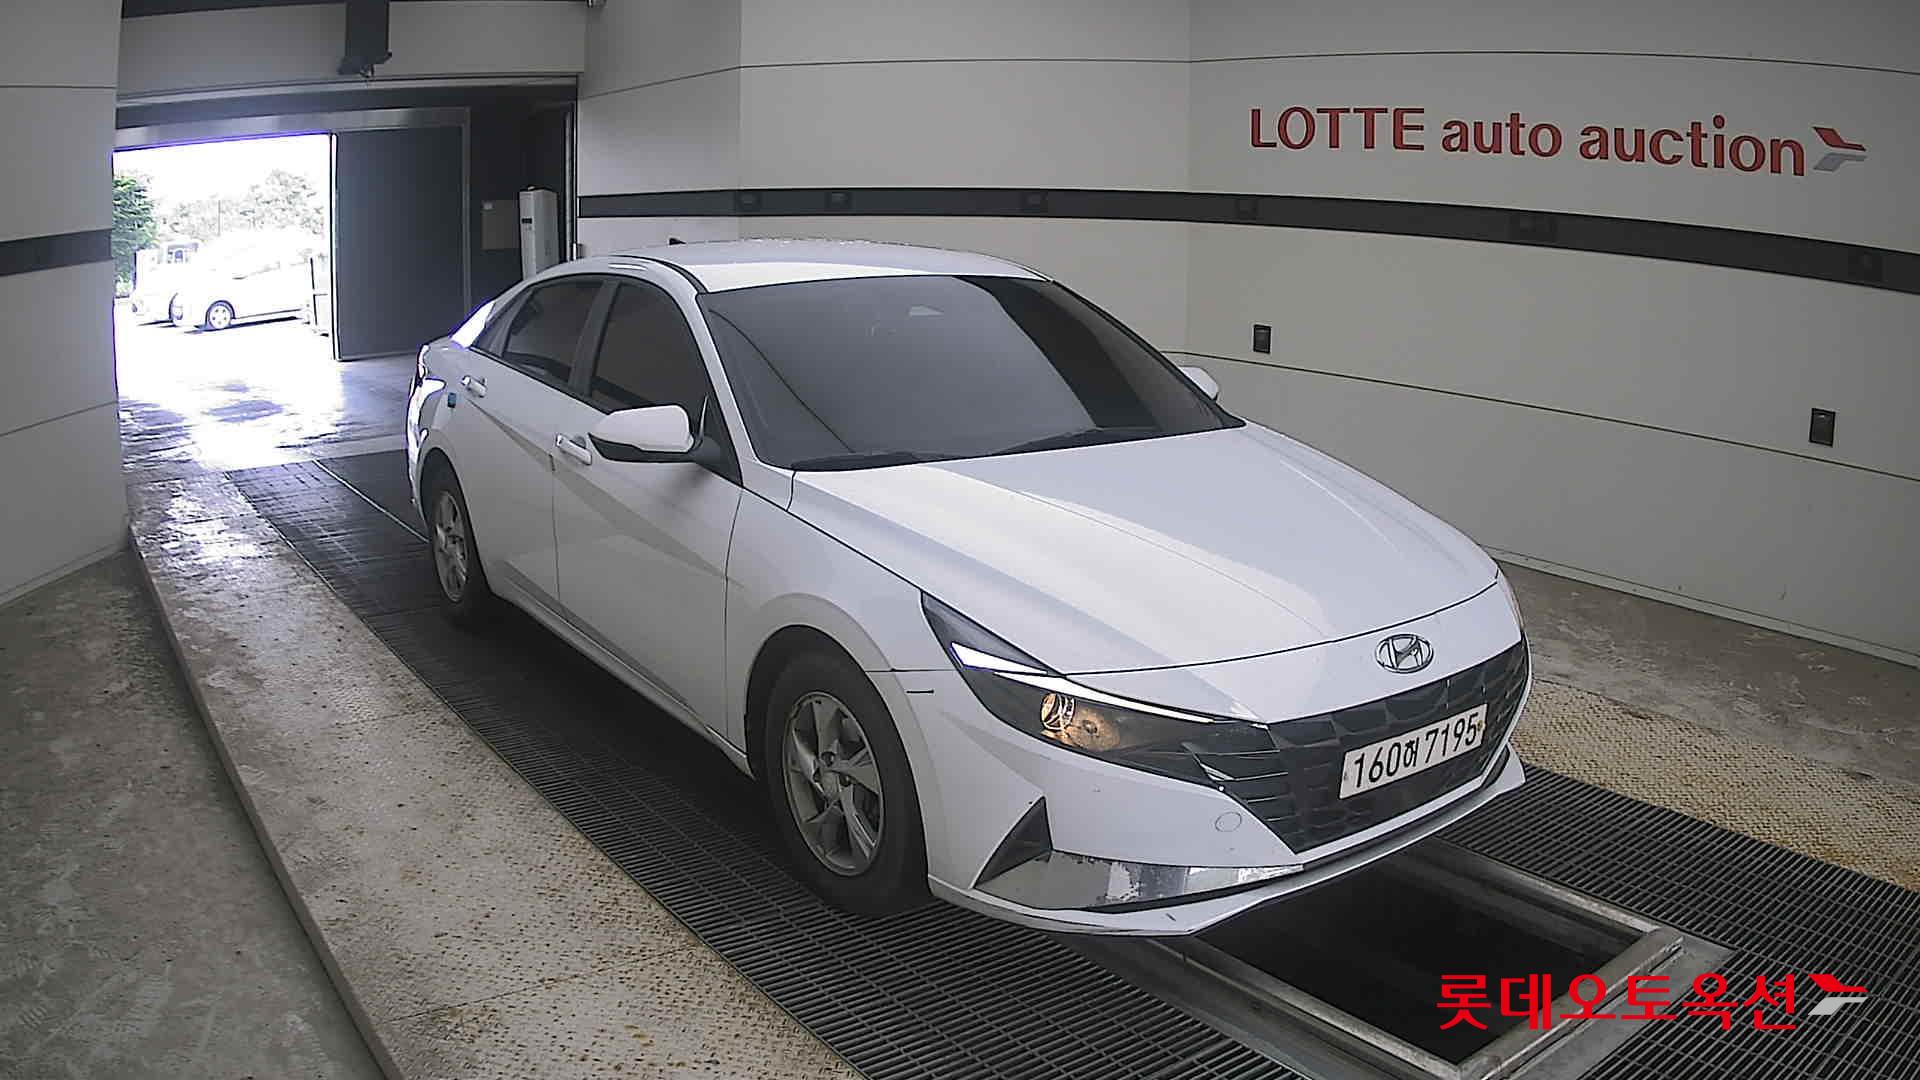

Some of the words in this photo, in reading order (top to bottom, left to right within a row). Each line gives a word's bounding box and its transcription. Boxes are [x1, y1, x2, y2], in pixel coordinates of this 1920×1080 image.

[1250, 106, 1425, 151] LOTTE
[1441, 112, 1562, 157] auto
[1579, 114, 1805, 177] auction
